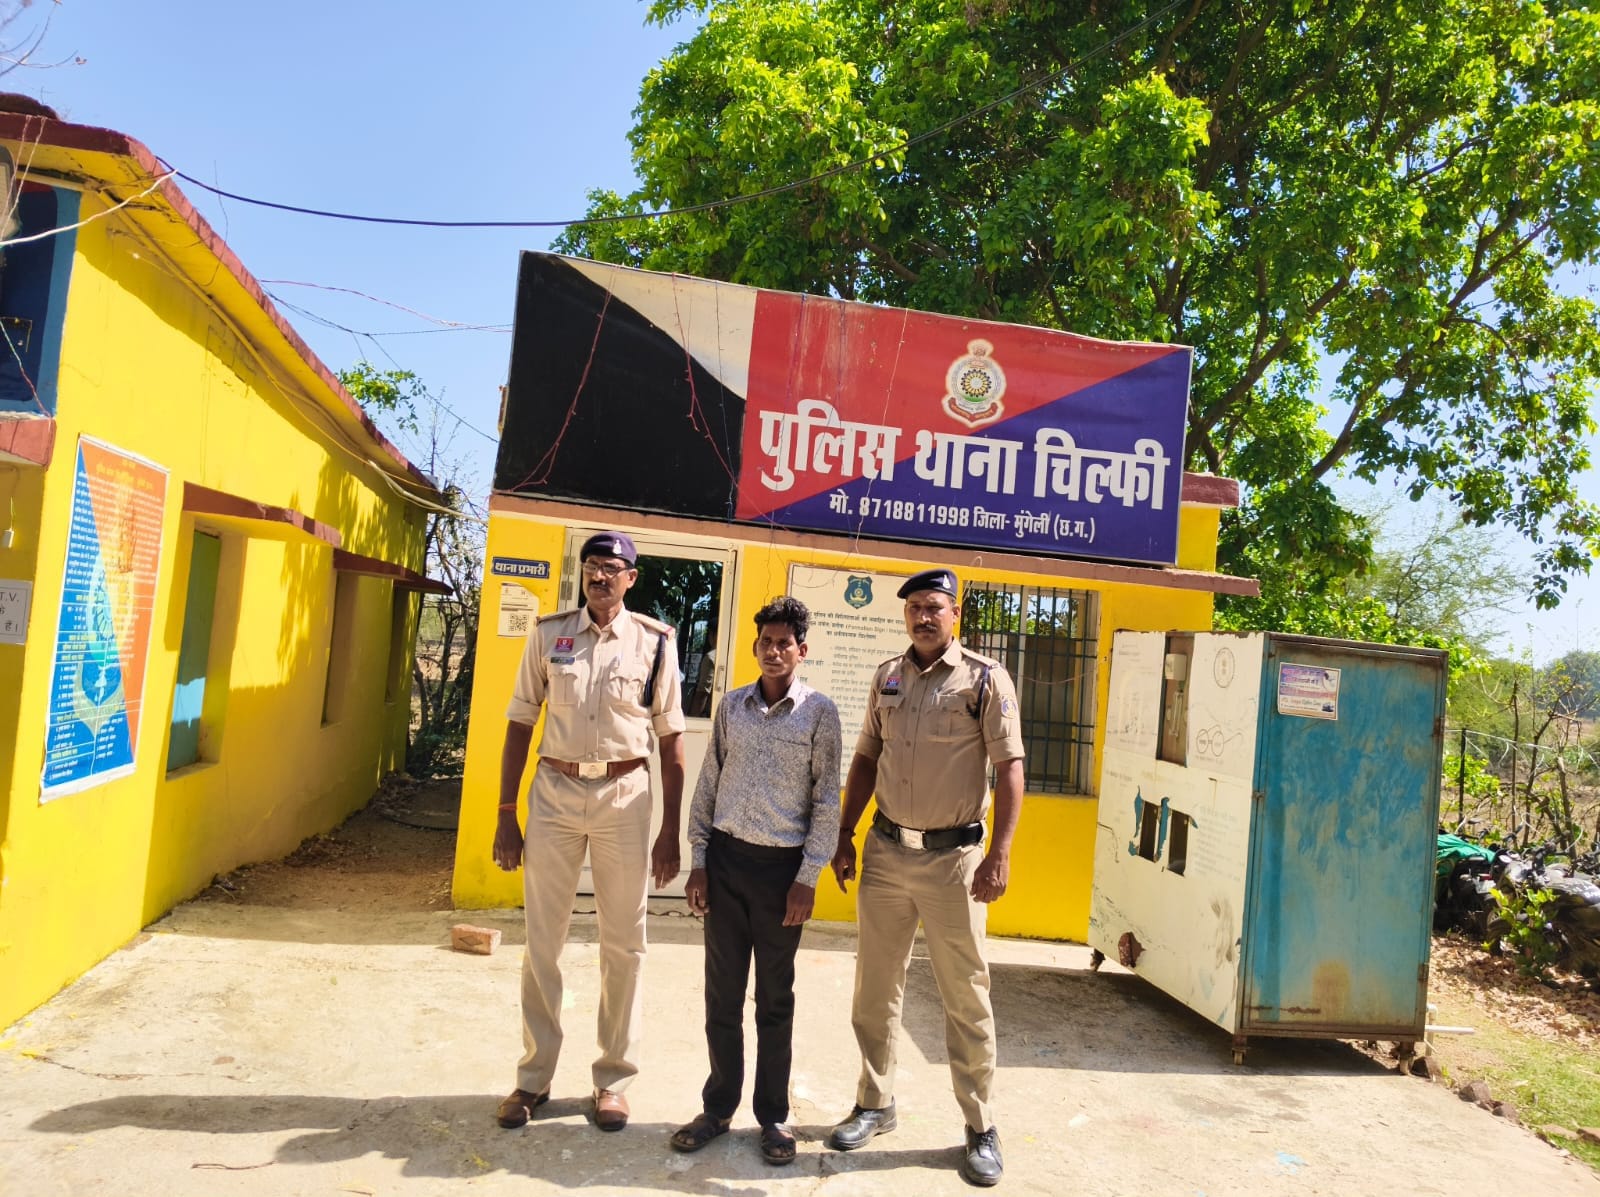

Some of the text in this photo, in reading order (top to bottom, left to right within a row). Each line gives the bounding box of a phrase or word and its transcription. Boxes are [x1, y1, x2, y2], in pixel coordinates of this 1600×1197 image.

[759, 398, 1171, 510] पुलिस थाना चिल्फी
[829, 488, 853, 515] मो.
[859, 496, 970, 527] 8718811998
[1014, 509, 1051, 538] मुंगेली
[1053, 513, 1096, 544] (छ.ग.)
[495, 562, 546, 576] थाना प्रभारी
